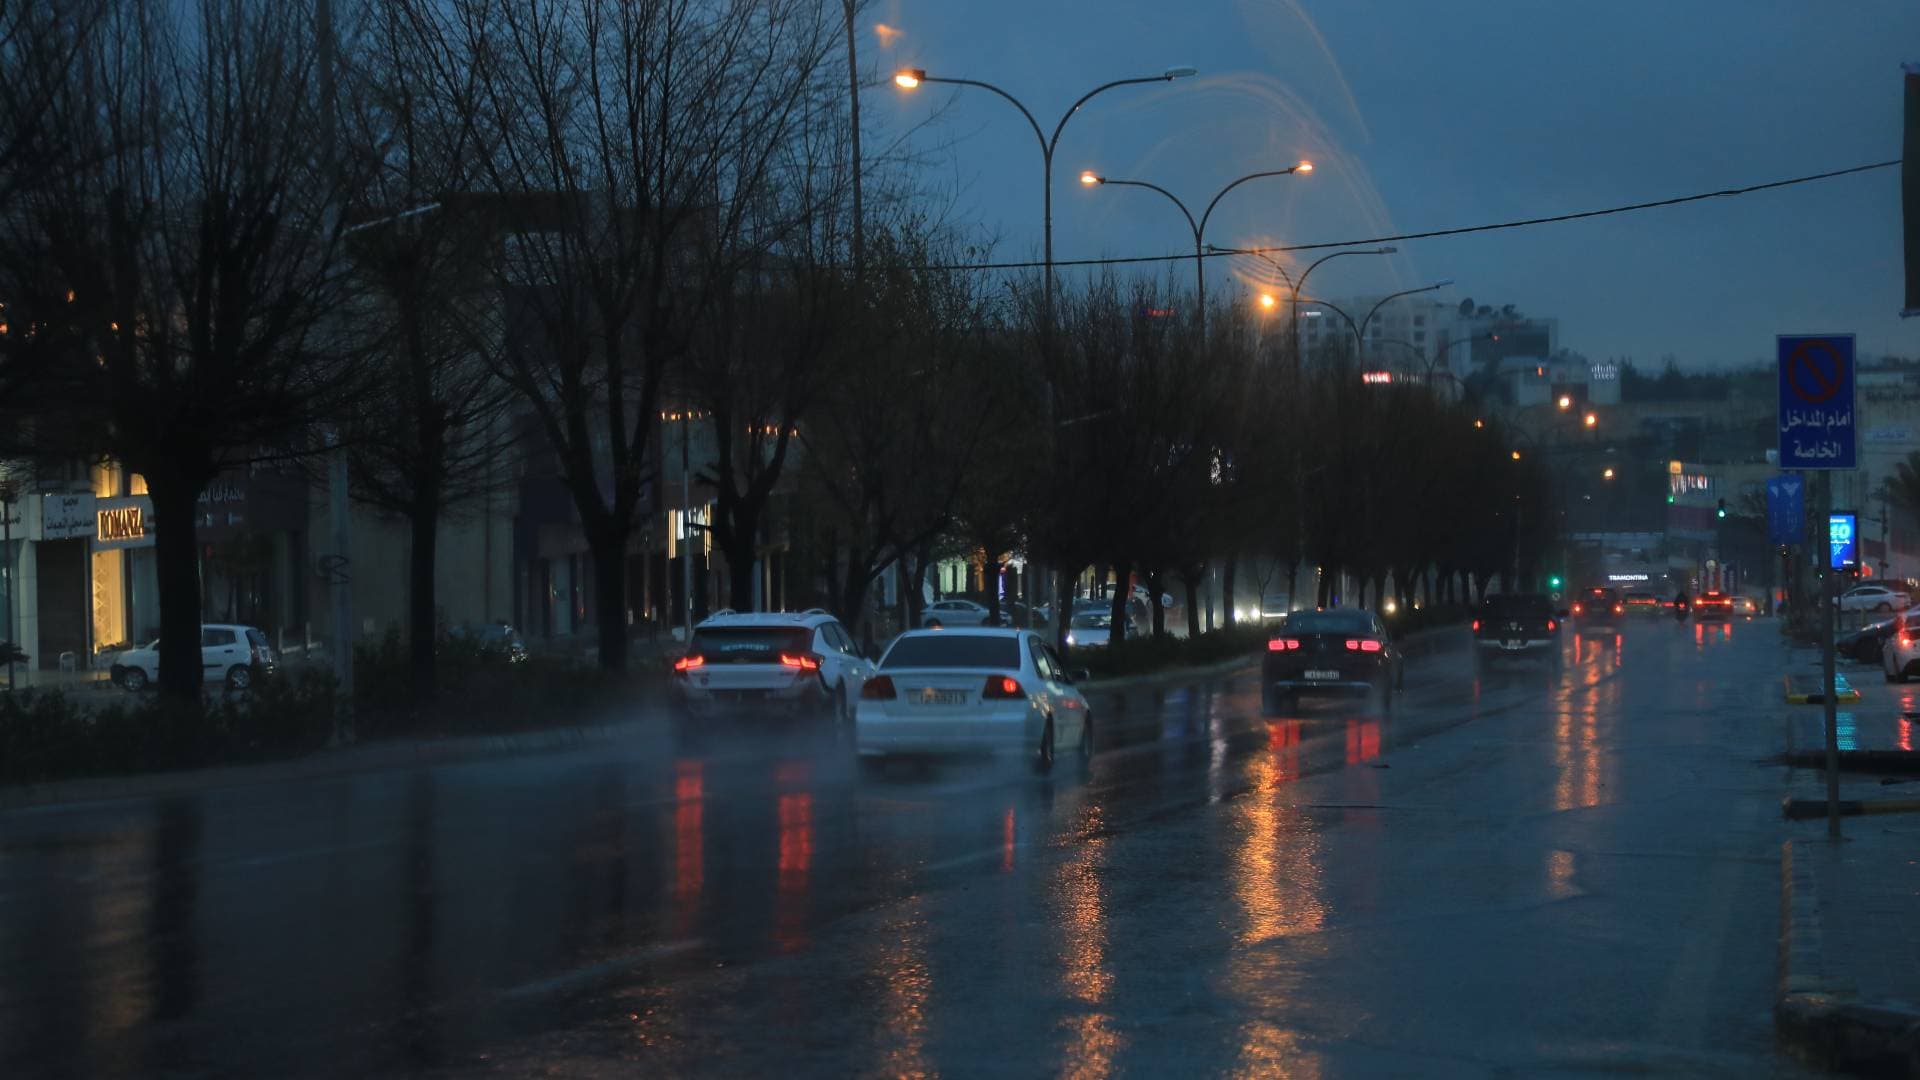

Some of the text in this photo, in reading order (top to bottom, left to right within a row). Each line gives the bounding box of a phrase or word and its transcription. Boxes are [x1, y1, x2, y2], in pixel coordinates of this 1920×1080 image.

[1780, 408, 1825, 433] المداخل
[1793, 439, 1841, 459] الخاصة
[97, 506, 145, 542] ROMANZA
